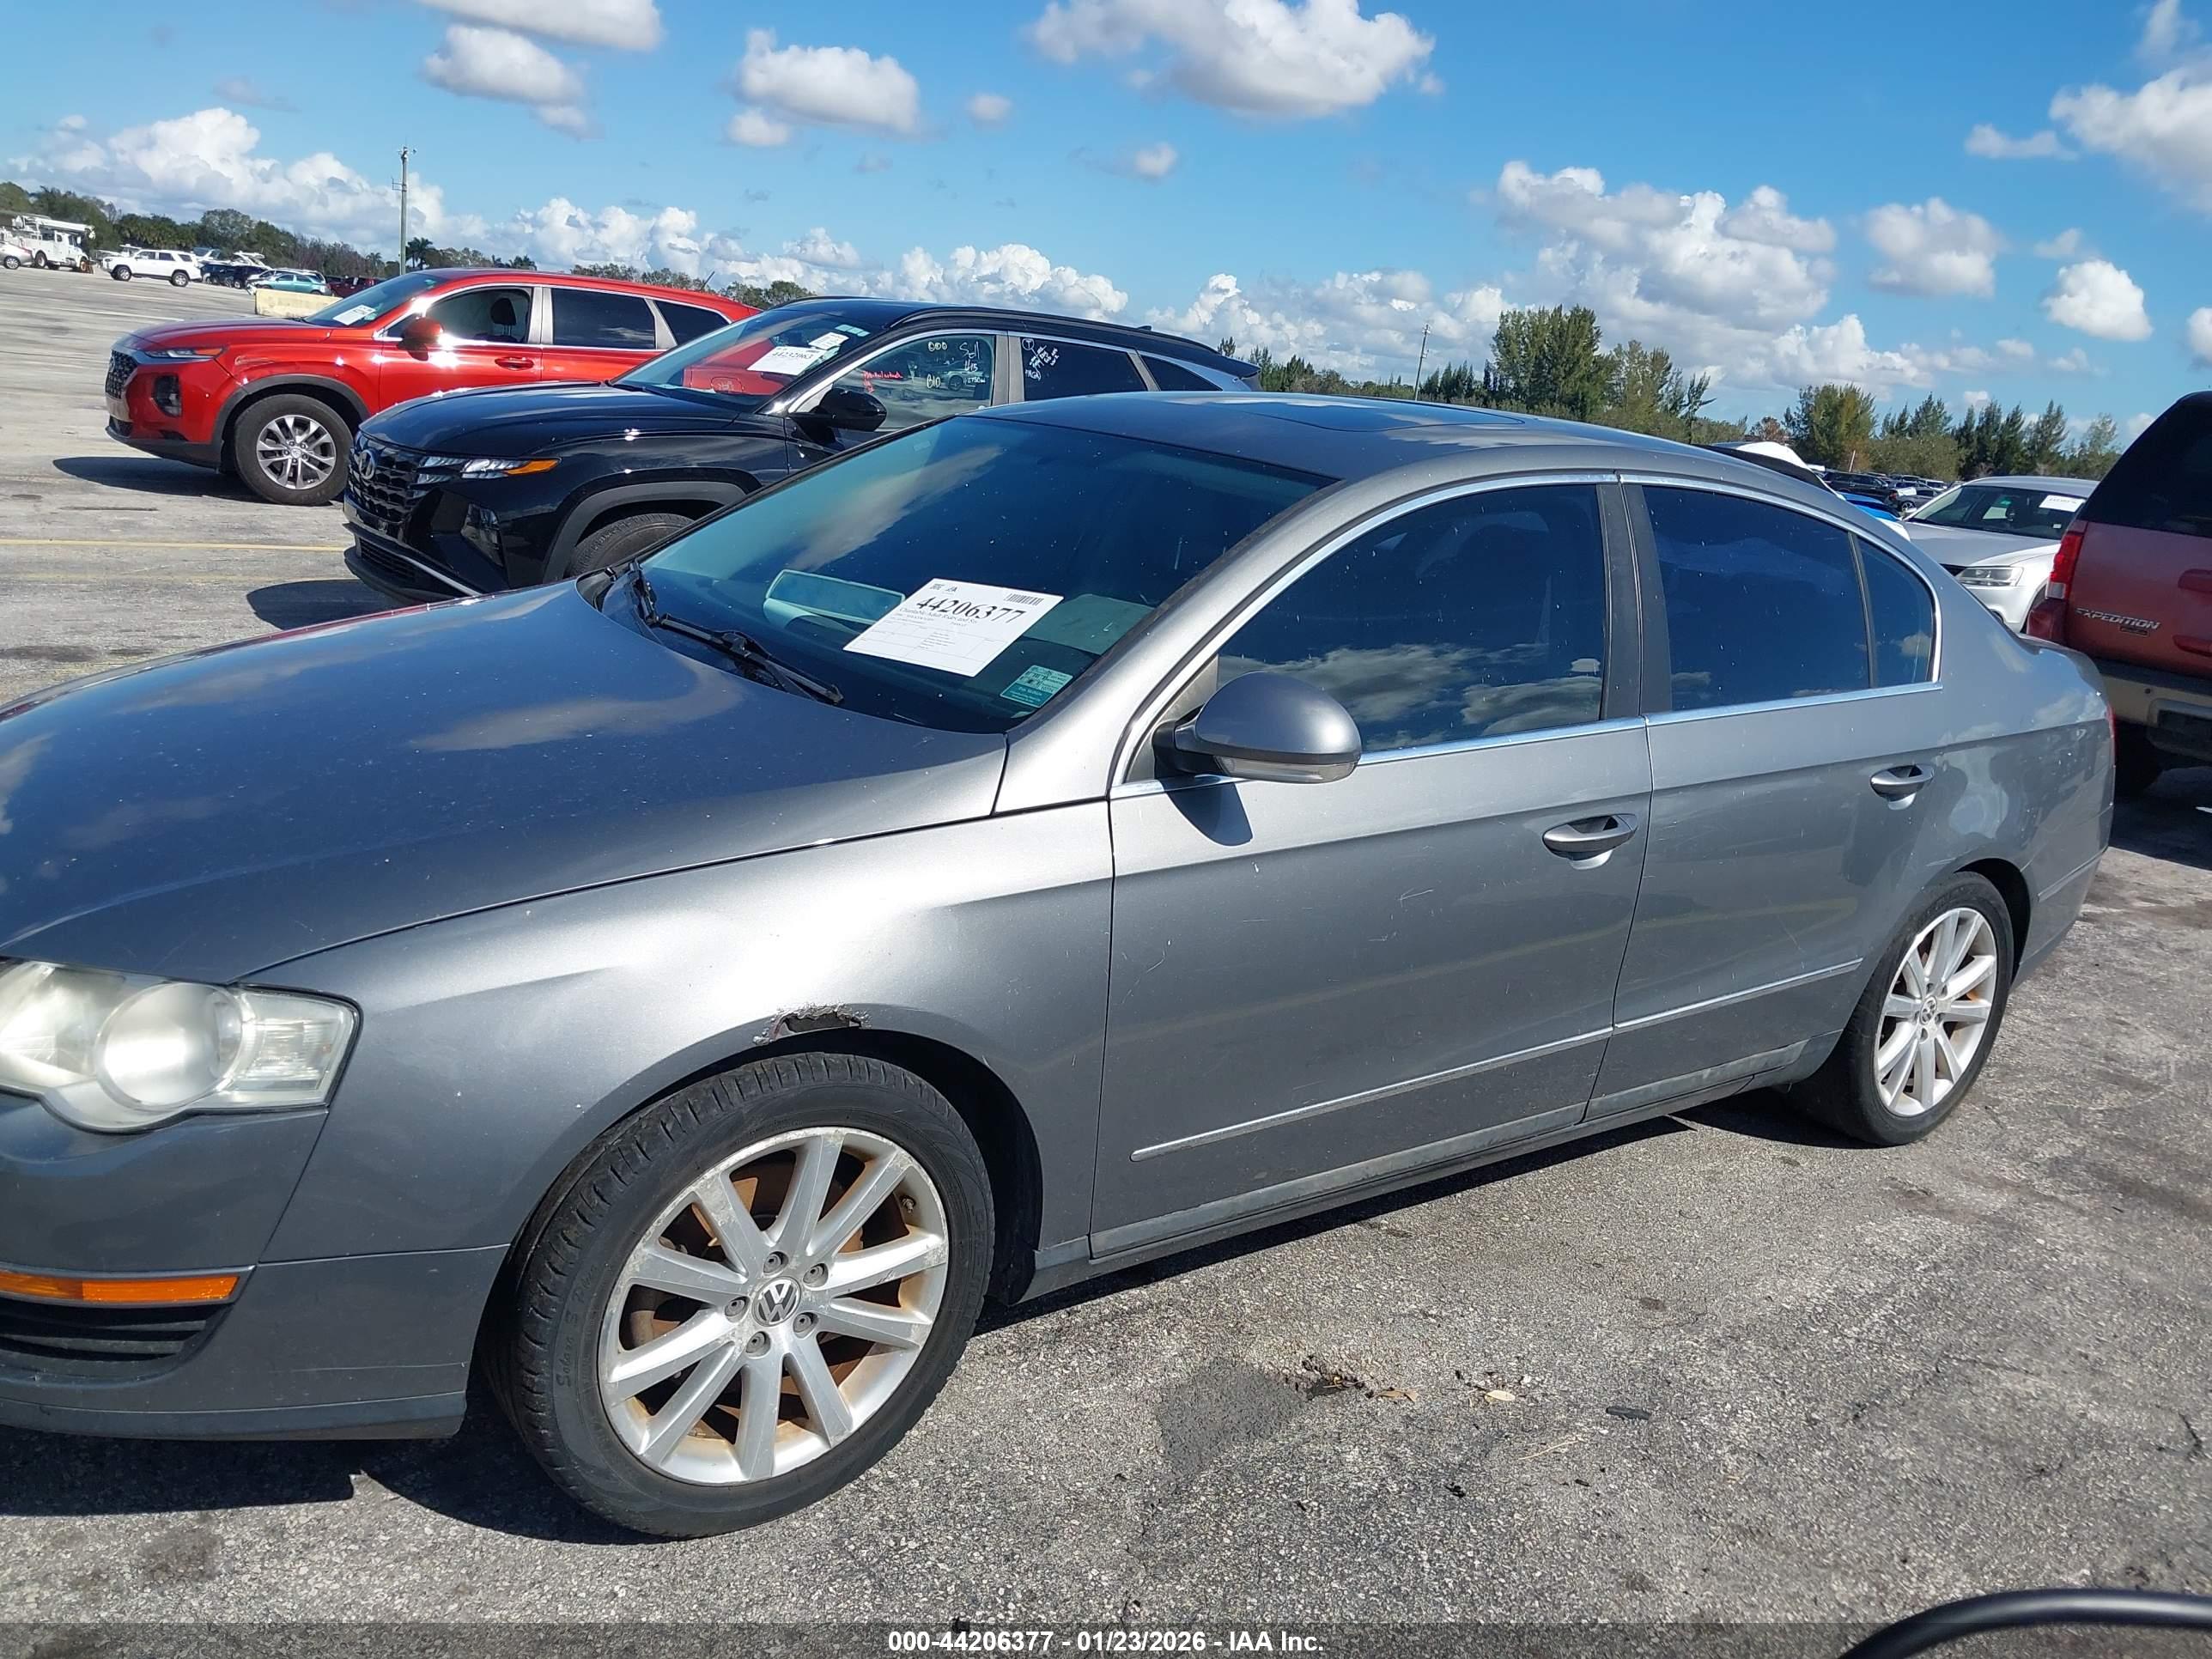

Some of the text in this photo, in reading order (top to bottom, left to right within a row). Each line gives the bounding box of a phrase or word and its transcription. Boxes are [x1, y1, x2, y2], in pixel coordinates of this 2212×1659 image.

[916, 596, 1027, 624] 44206377
[2075, 607, 2161, 629] EXPEDITION
[754, 1278, 799, 1326] VW
